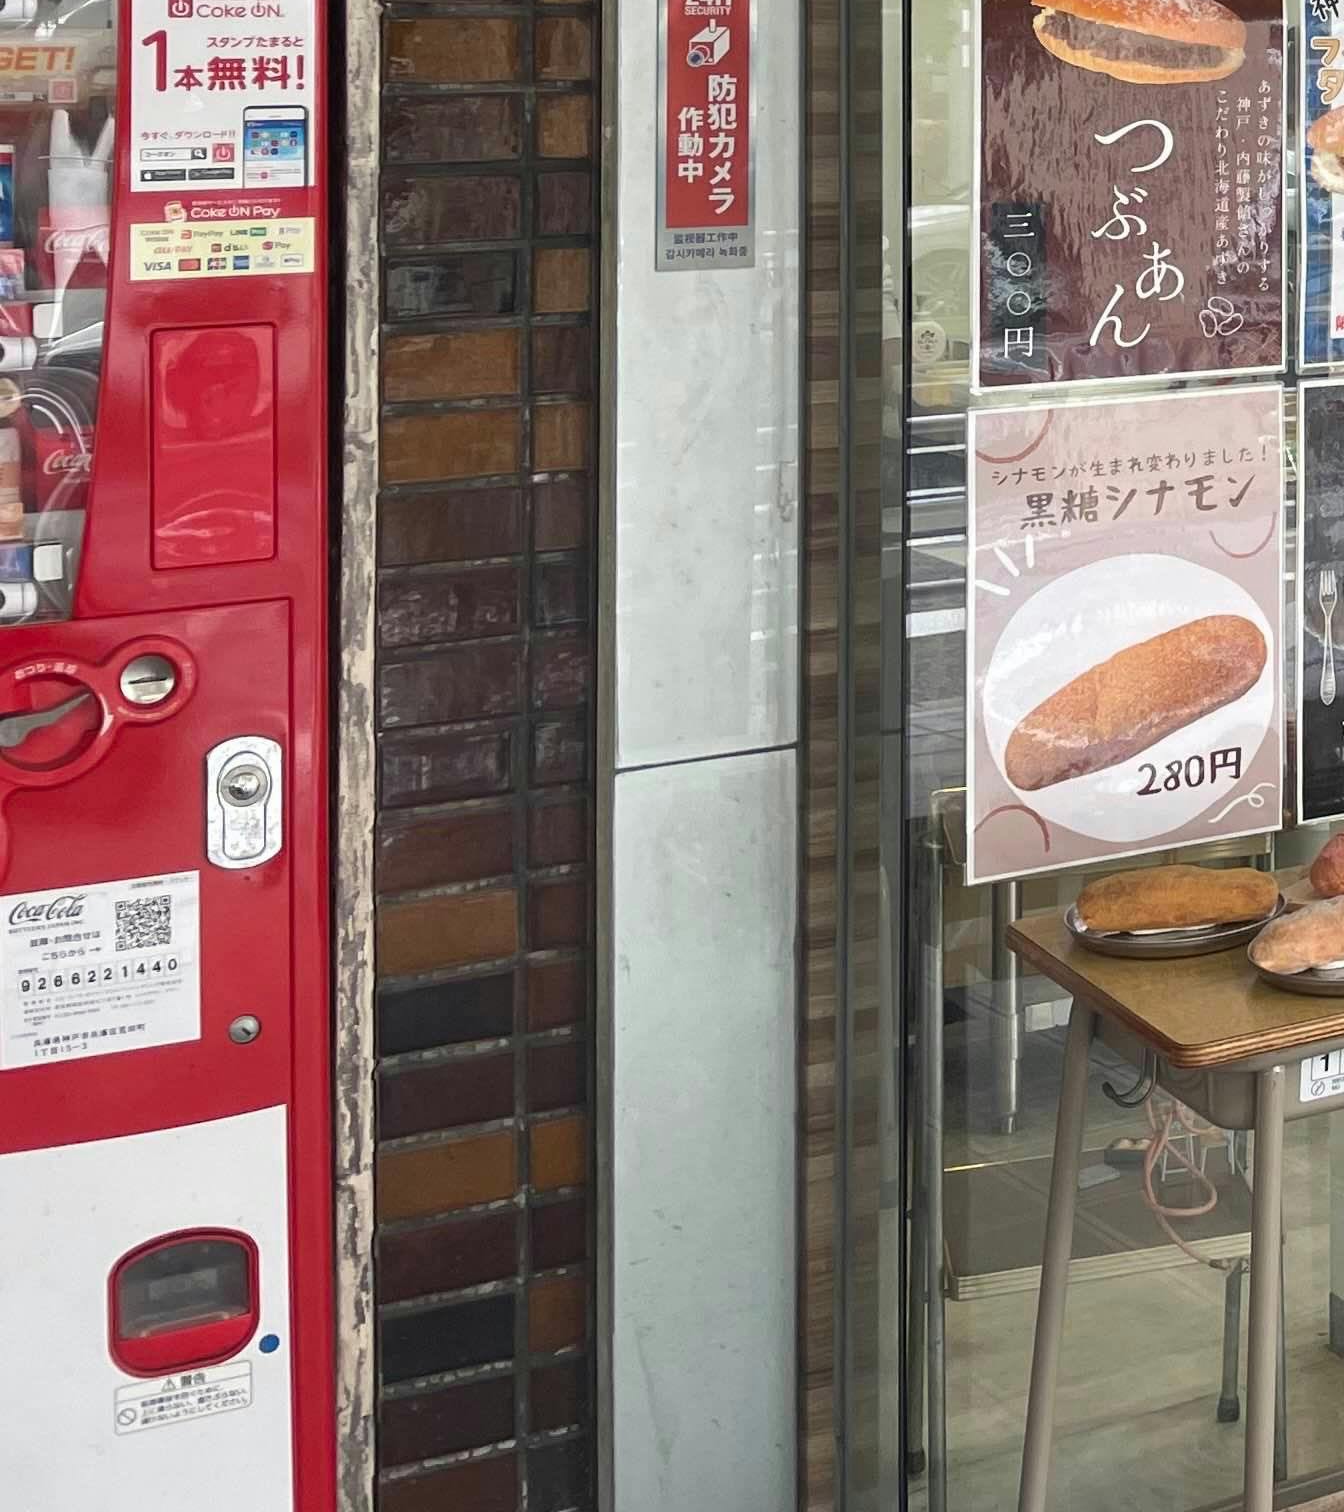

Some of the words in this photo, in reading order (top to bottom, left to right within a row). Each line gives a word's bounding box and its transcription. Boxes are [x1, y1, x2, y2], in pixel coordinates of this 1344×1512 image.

[196, 4, 247, 18] Coke
[250, 2, 281, 18] ON
[684, 6, 732, 16] SECURITY
[206, 36, 305, 49] スタンプたまると
[677, 107, 704, 184] 作動中
[708, 74, 738, 215] 防犯カメラ
[190, 207, 227, 219] Coke
[252, 206, 281, 218] Pay
[1089, 118, 1186, 349] つぶあん
[143, 261, 172, 271] VISA
[991, 444, 1270, 487] シナモンが生まれ変わりました!
[1020, 473, 1257, 530] 黒糖シナモン
[1135, 746, 1243, 797] 280円
